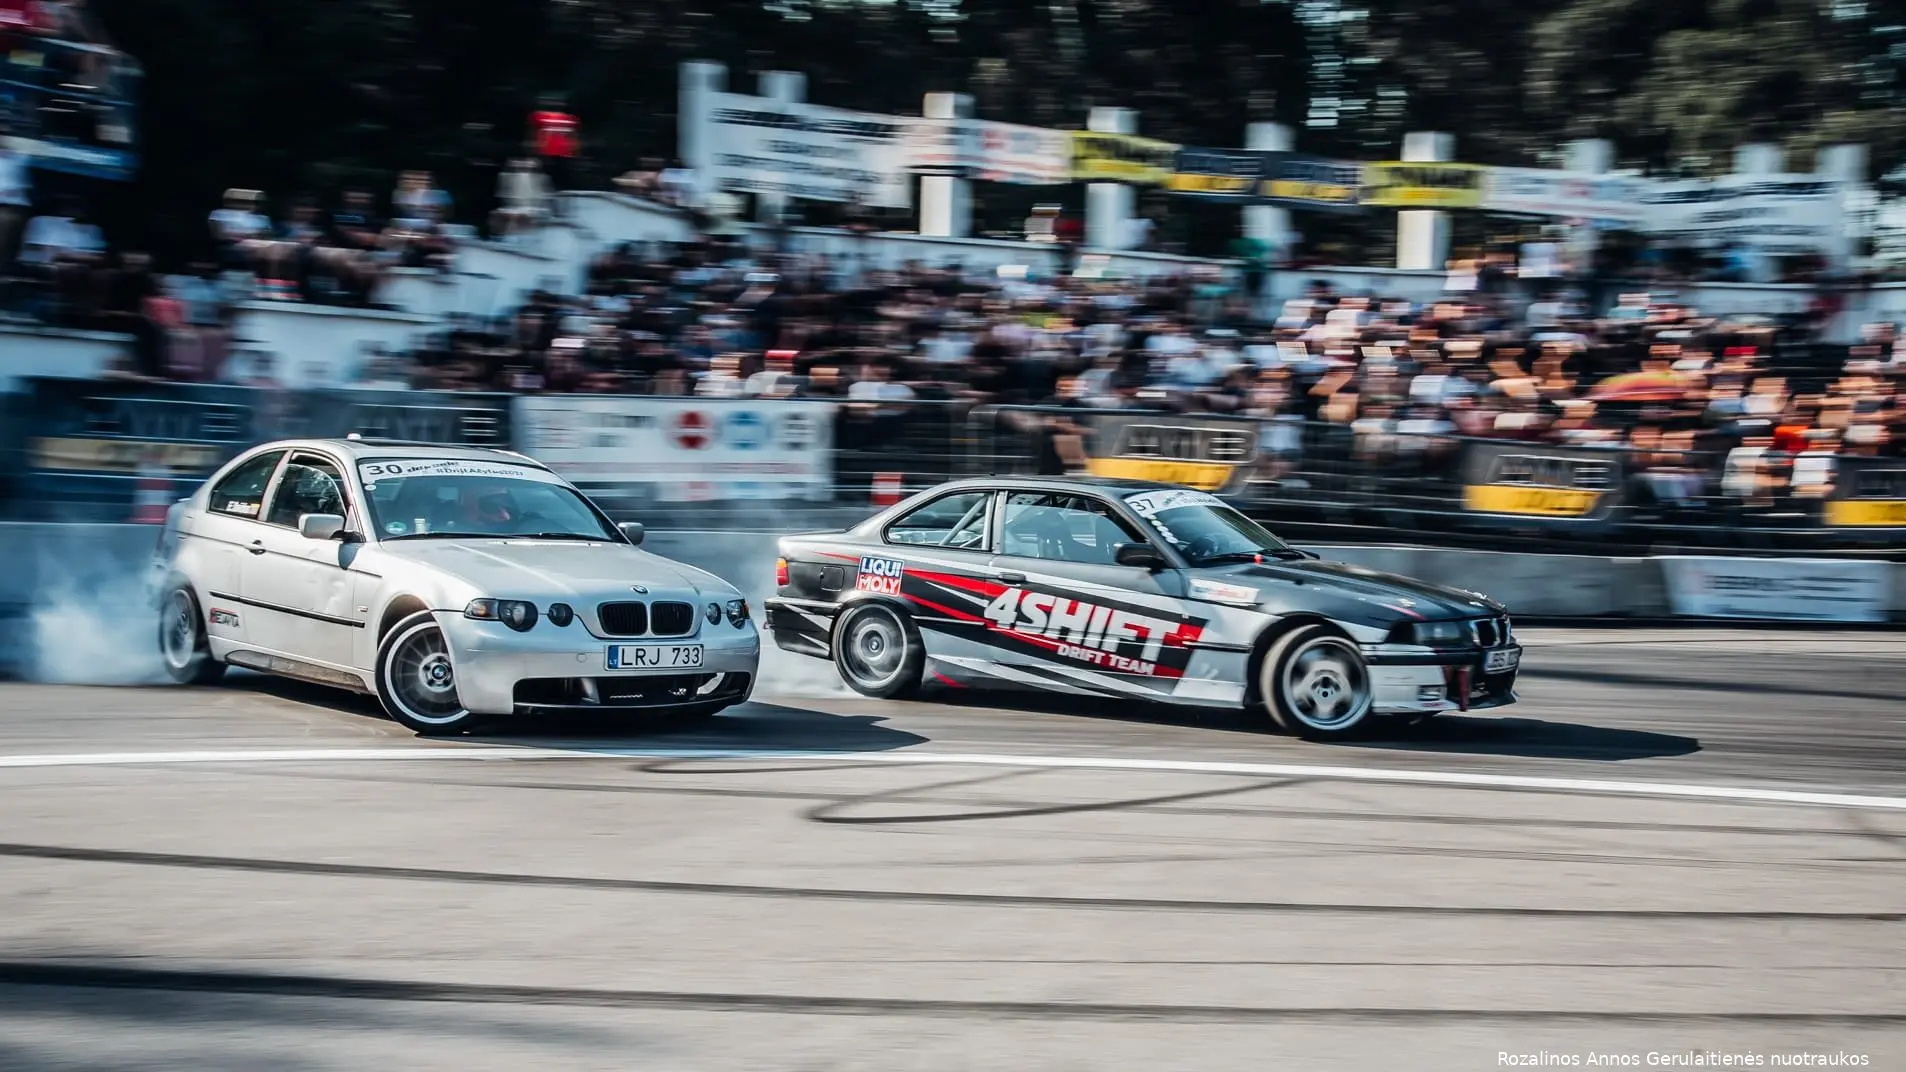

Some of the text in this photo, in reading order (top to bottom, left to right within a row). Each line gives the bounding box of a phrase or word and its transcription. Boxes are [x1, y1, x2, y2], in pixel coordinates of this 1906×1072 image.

[366, 464, 403, 475] 30
[1129, 498, 1155, 511] 37
[861, 557, 902, 577] LIQUI
[858, 574, 900, 595] MOLY
[984, 587, 1180, 662] 4SHIFT
[621, 647, 700, 666] LRJ 733
[1056, 643, 1156, 676] DRIFT TEAM
